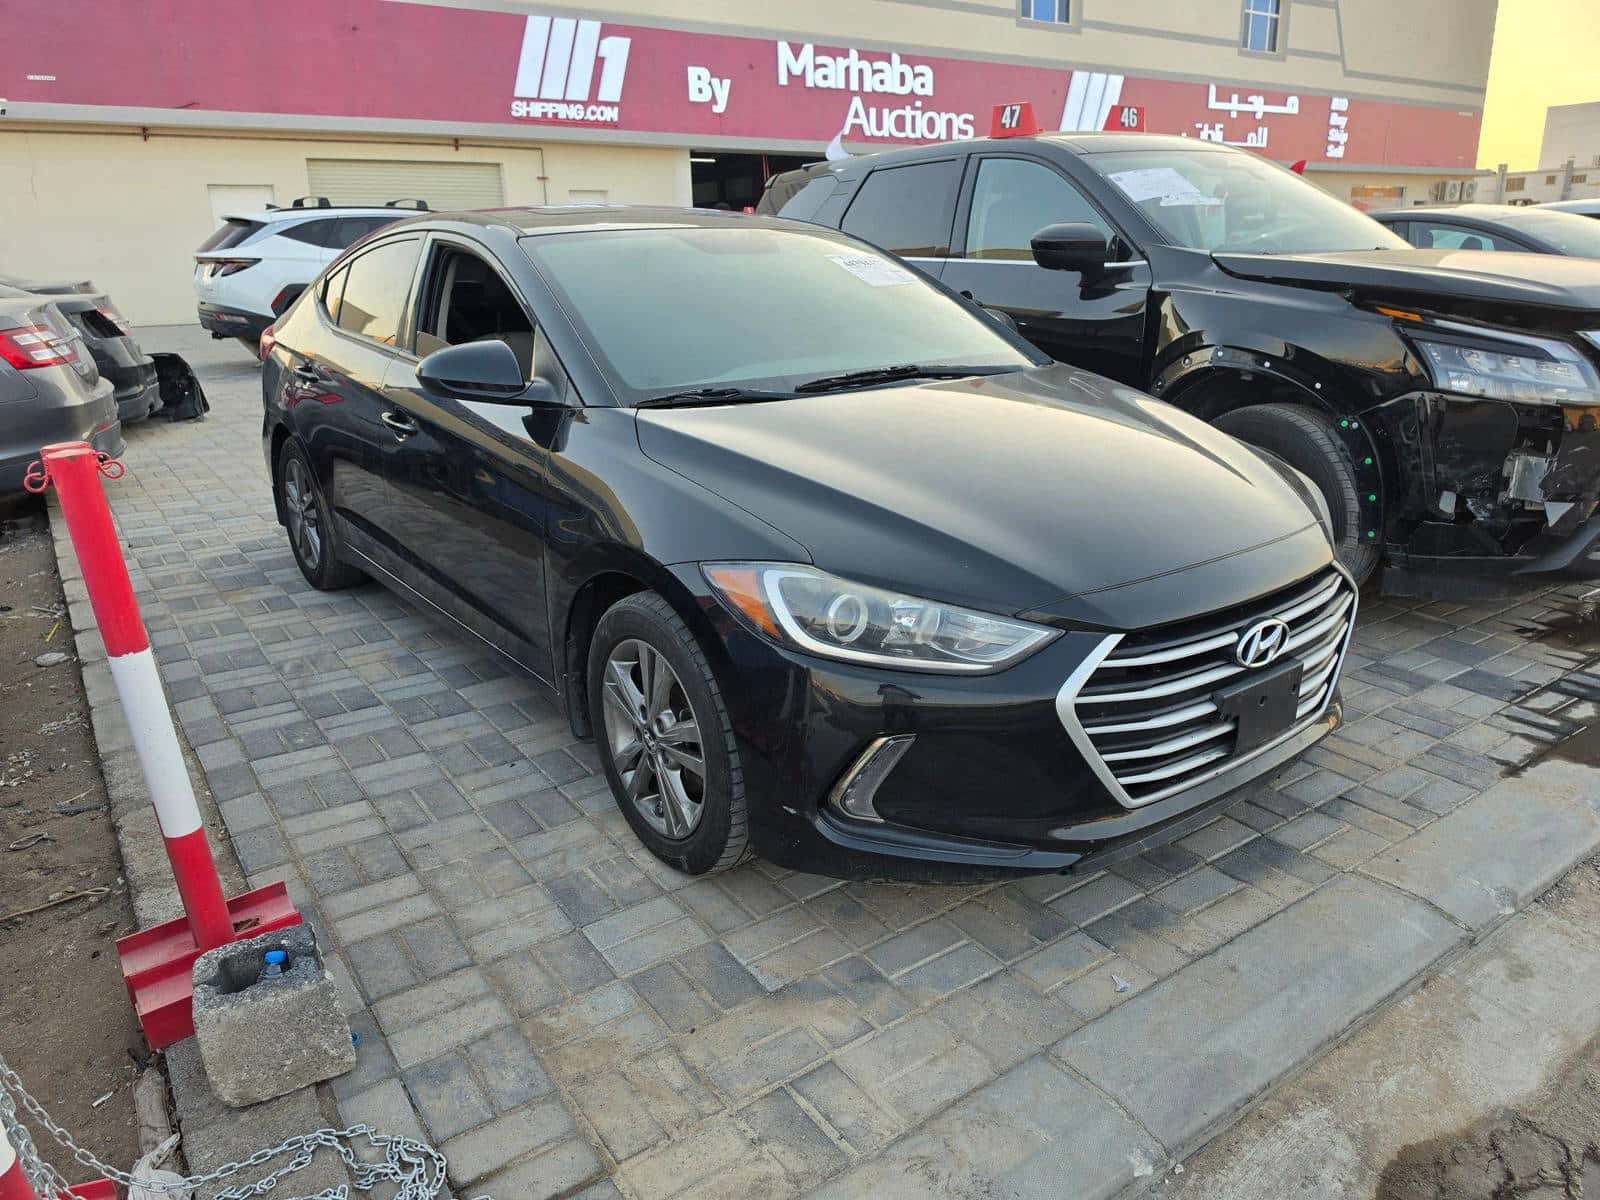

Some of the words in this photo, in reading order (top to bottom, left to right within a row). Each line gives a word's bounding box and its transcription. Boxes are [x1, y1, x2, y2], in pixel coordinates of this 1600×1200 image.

[777, 41, 934, 97] Marhaba
[687, 65, 731, 114] By
[510, 101, 619, 122] SHIPPING.COM
[842, 95, 975, 140] Auctions
[1001, 104, 1021, 129] 47
[1119, 107, 1138, 128] 46
